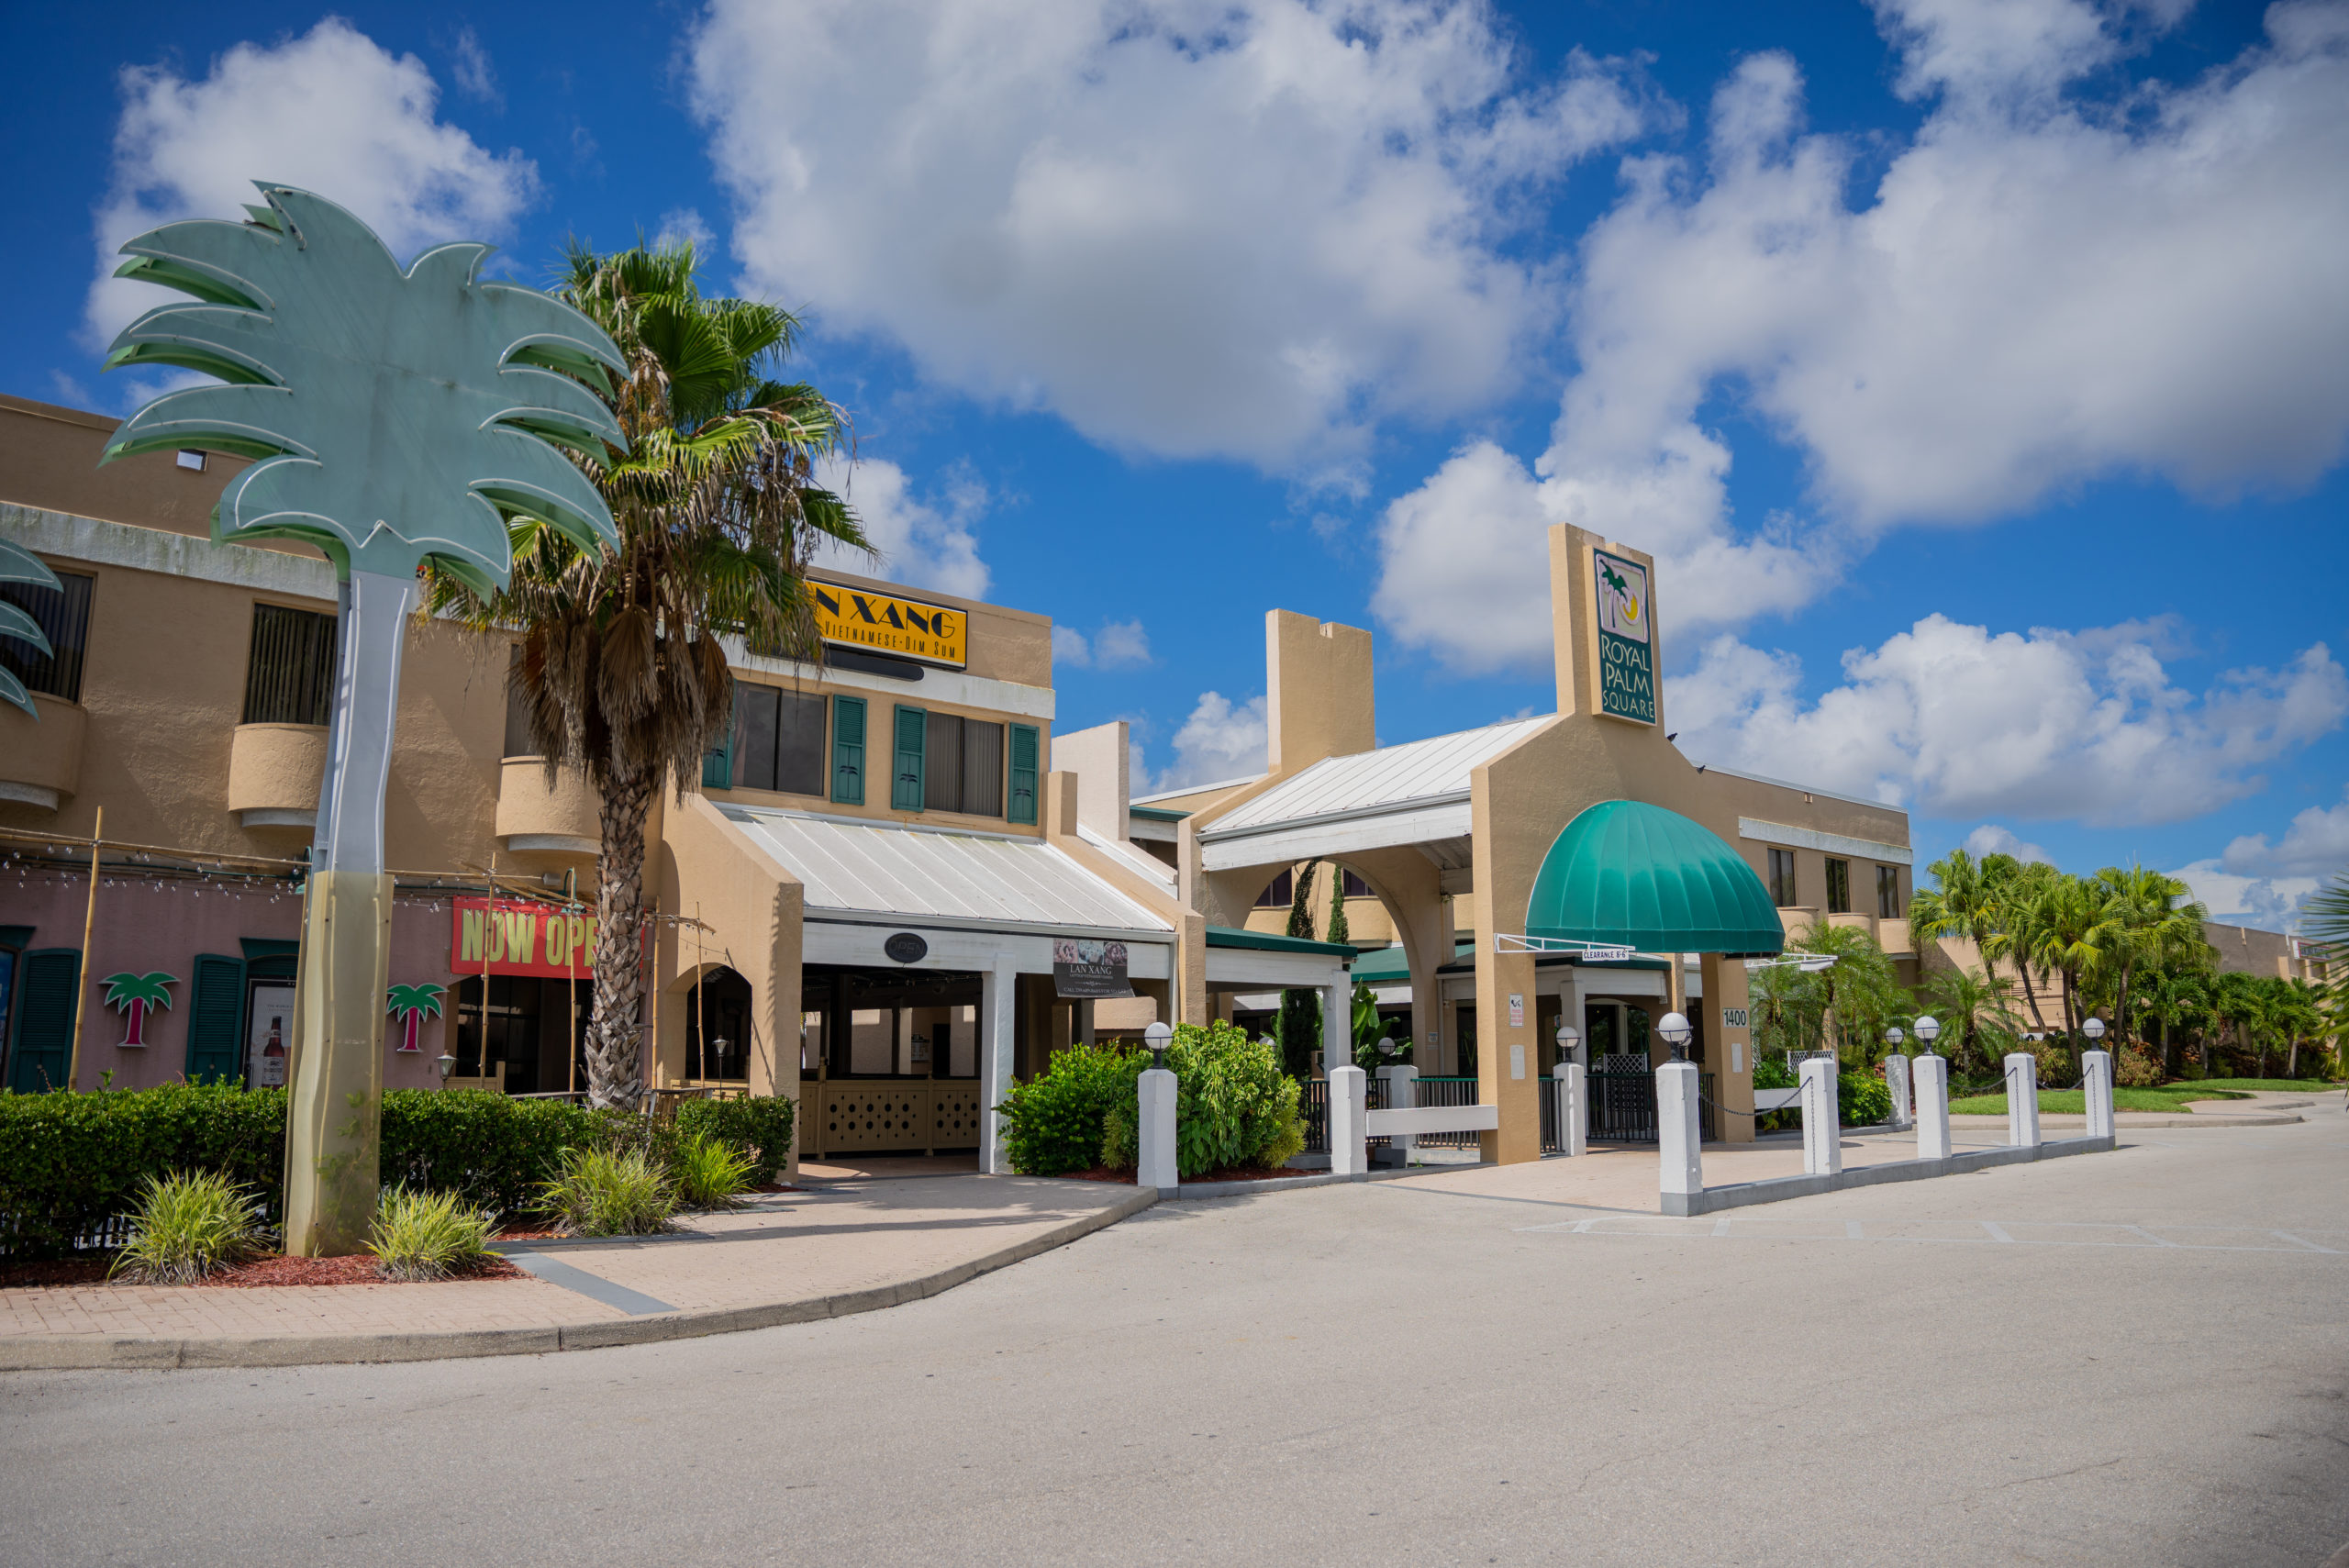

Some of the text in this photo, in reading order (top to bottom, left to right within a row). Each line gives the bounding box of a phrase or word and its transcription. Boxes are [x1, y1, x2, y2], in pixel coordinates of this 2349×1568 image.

[850, 595, 955, 639] XANG
[934, 641, 955, 659] SUM
[1601, 634, 1650, 672] ROYAL
[1606, 662, 1650, 697] PALM
[1603, 690, 1654, 718] SQUARE
[461, 908, 598, 966] NOW OPE
[1584, 951, 1614, 959] CLEARANCE
[1070, 964, 1112, 975] LAN XANG
[1724, 1010, 1746, 1026] 1400
